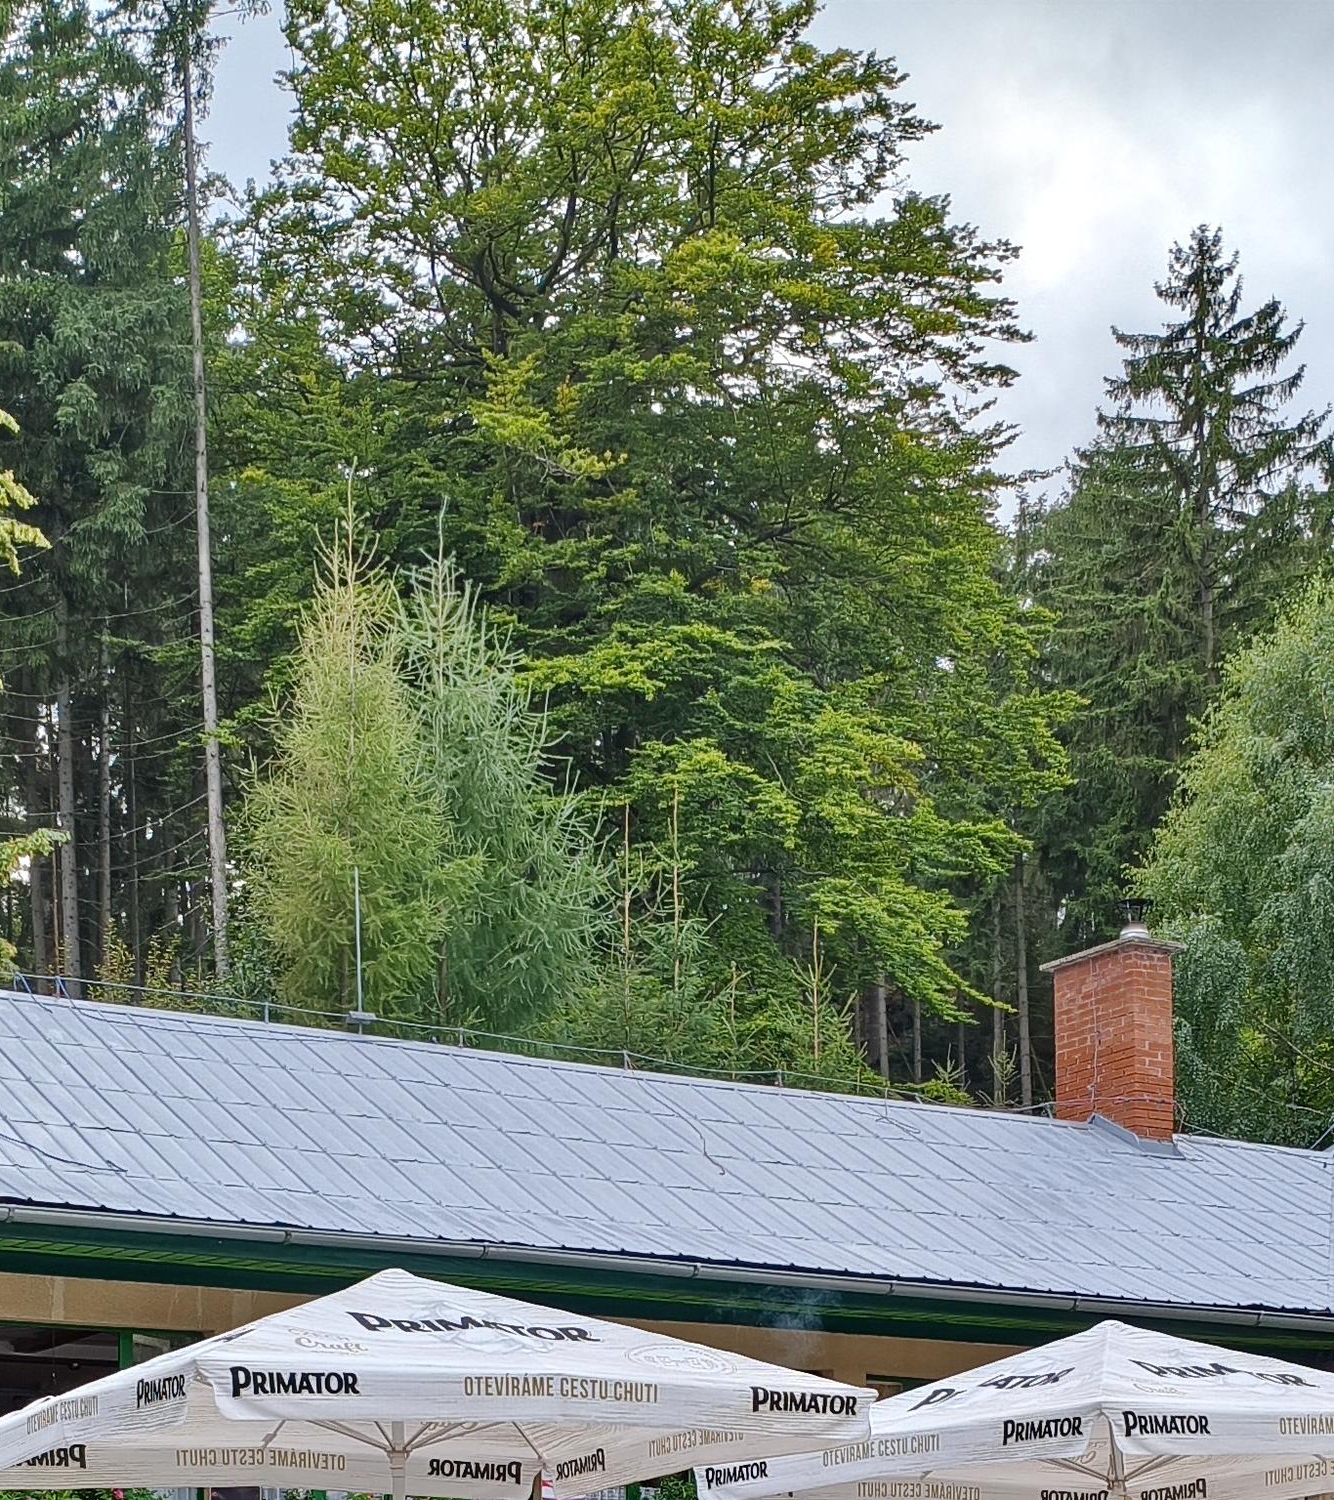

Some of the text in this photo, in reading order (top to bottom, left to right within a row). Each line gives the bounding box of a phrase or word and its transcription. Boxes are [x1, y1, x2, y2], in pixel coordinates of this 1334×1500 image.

[137, 1375, 186, 1408] PRIMATOR
[230, 1365, 360, 1398] PRIMATOR
[463, 1373, 658, 1403] OTEVÍRÁME CESTU CHUTI
[750, 1386, 858, 1415] PRIMATOR
[1003, 1416, 1083, 1446] PRIMATOR
[1122, 1411, 1211, 1437] PRIMATOR
[878, 1438, 909, 1458] CESTU
[911, 1434, 940, 1454] CHUTI
[706, 1461, 768, 1490] PRIMATOR
